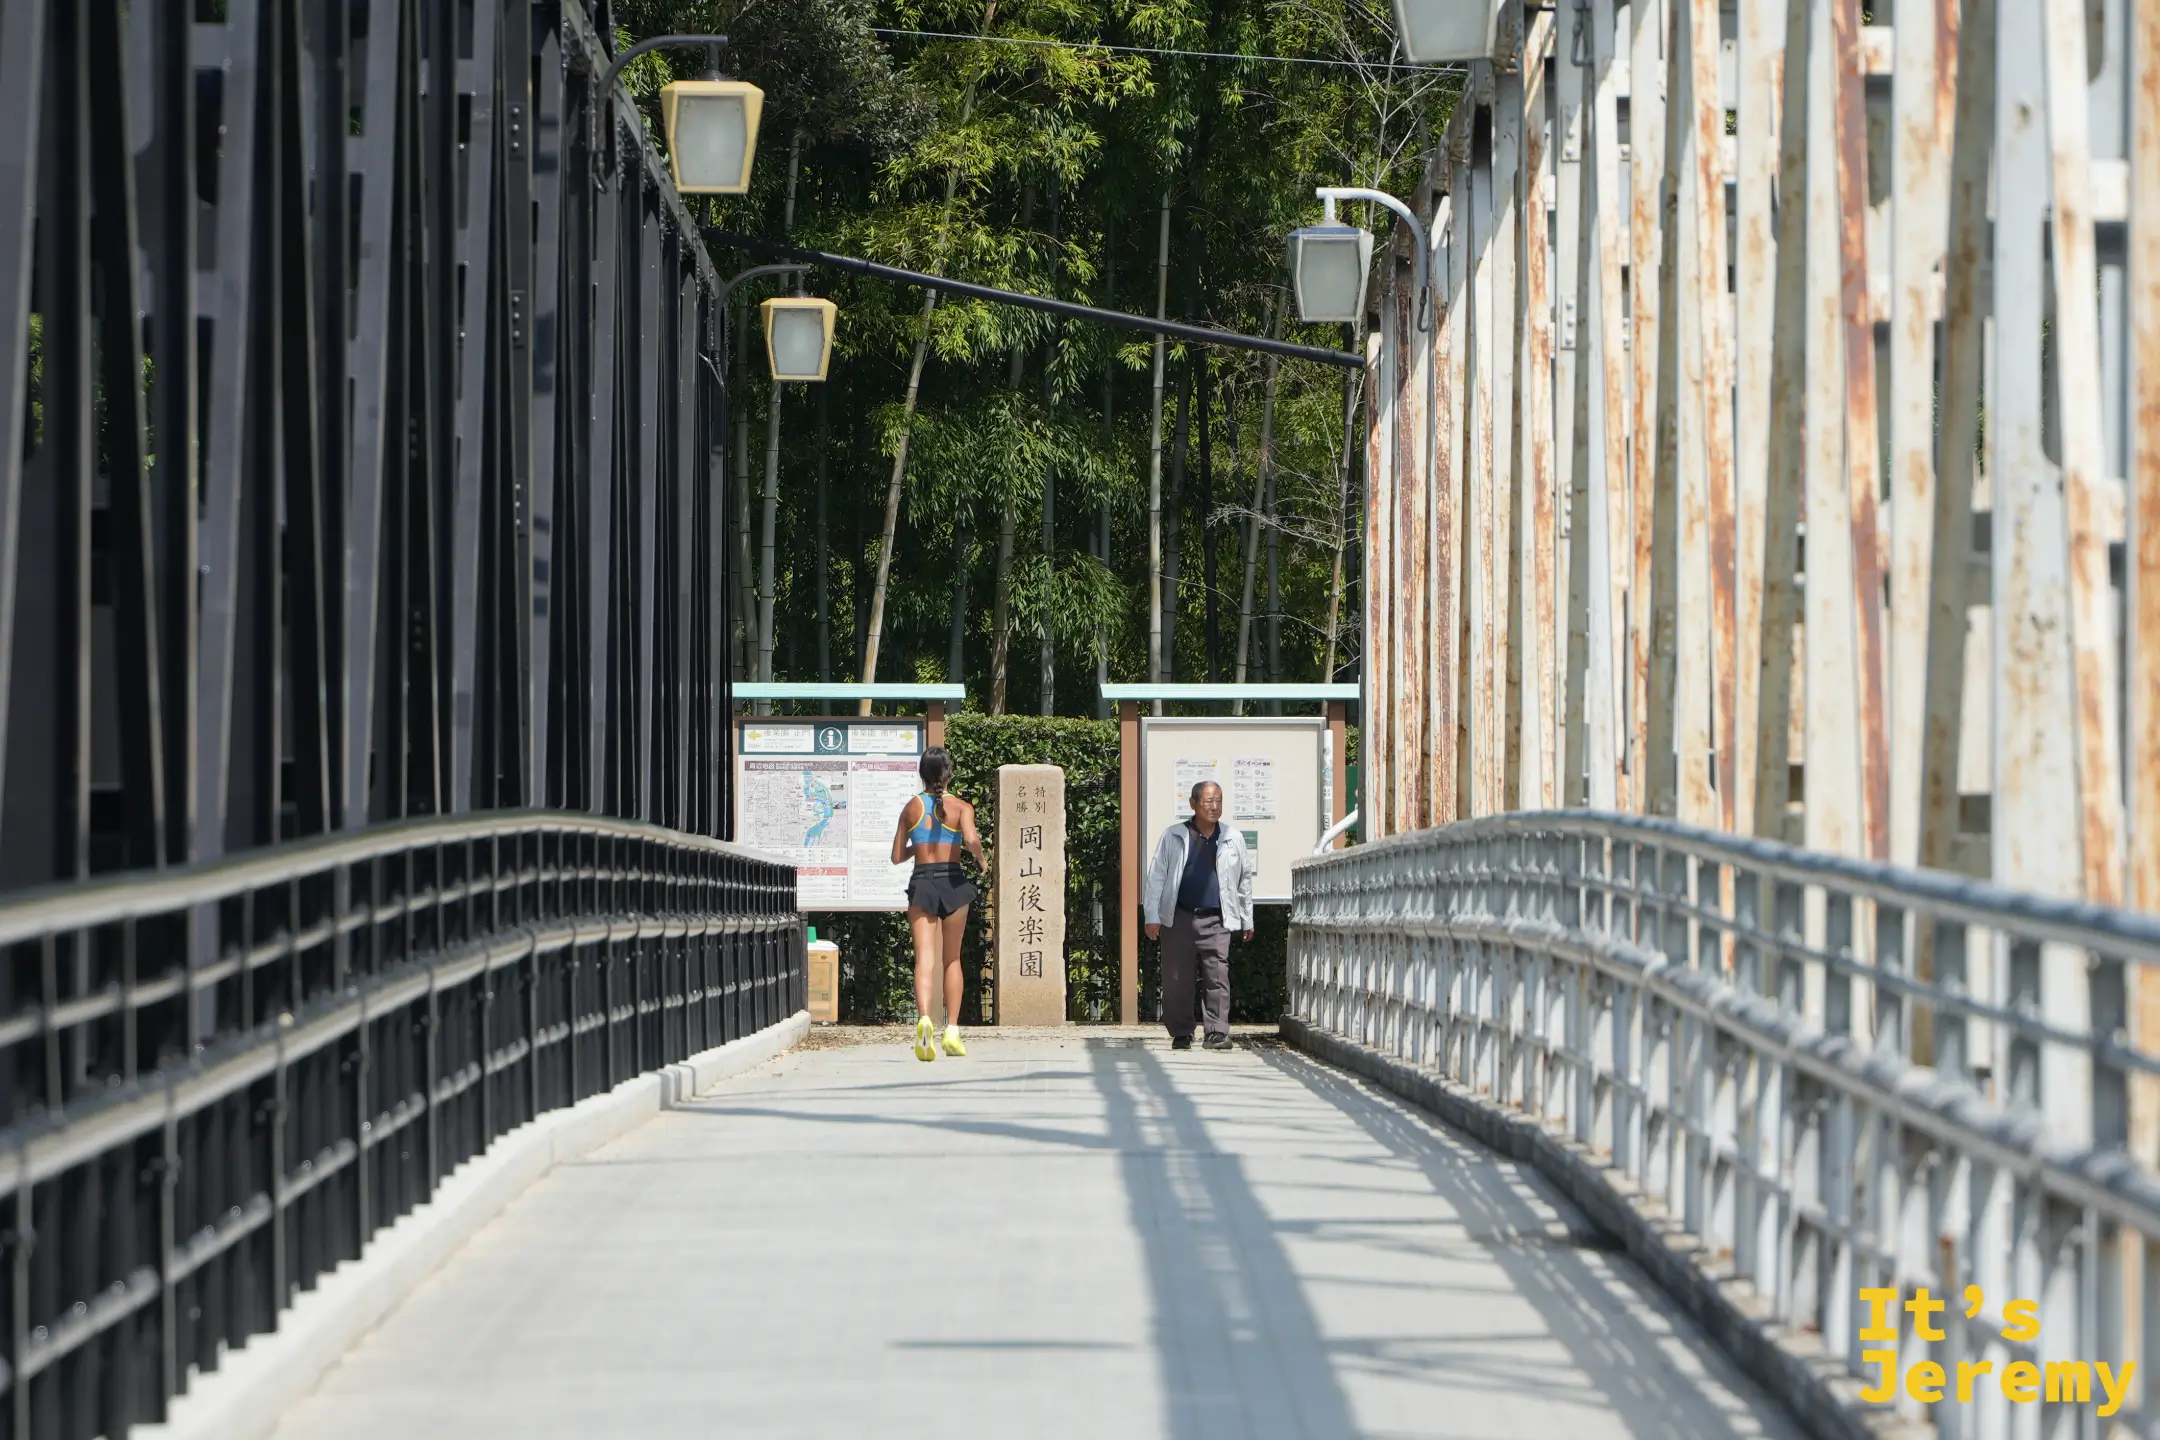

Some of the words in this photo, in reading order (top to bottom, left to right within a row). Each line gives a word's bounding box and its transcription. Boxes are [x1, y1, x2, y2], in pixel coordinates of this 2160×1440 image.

[1016, 785, 1028, 814] 名勝
[1034, 785, 1047, 814] 特別
[1017, 824, 1047, 979] 岡山後楽園
